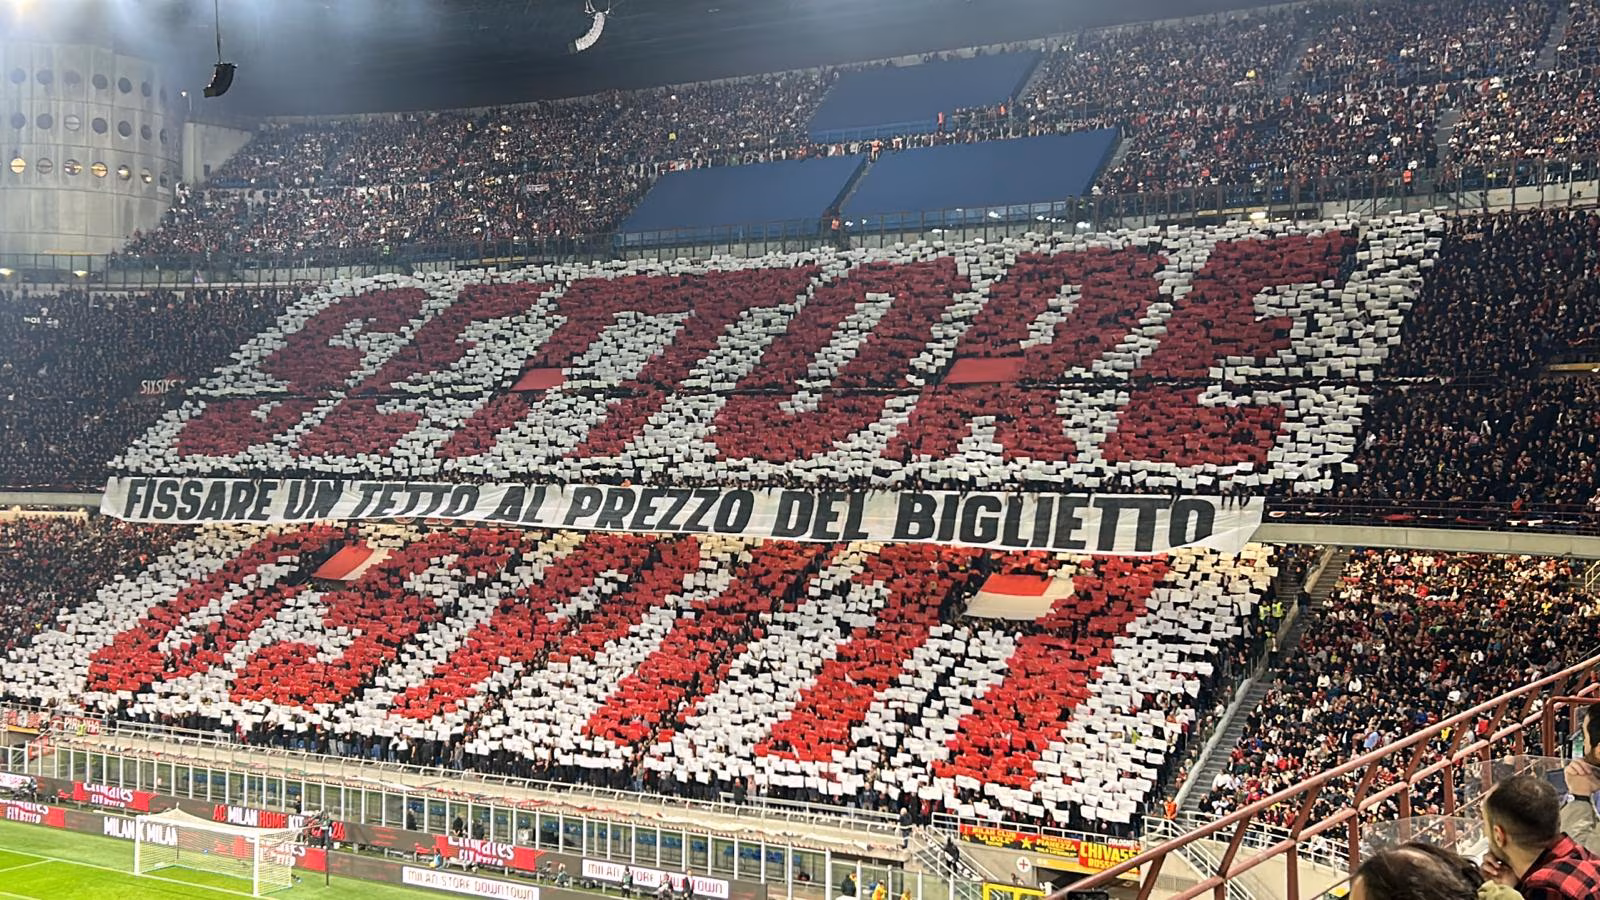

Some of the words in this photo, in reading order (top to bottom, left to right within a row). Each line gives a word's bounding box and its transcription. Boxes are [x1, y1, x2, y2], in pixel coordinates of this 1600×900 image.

[123, 478, 277, 521] FISSARE
[284, 480, 345, 520] UN
[352, 482, 480, 518] TETTO
[485, 485, 548, 523] AL
[562, 486, 754, 532] PREZZO
[771, 489, 868, 540] DEL
[893, 490, 1216, 552] BIGLIETTO
[103, 816, 136, 841] MILAN
[212, 804, 226, 823] AC
[227, 806, 258, 827] MILAN
[259, 809, 288, 828] HOME
[288, 814, 305, 831] KIT
[407, 870, 438, 885] MILAN
[442, 874, 471, 890] STORE
[475, 882, 534, 900] DOWNTOWN
